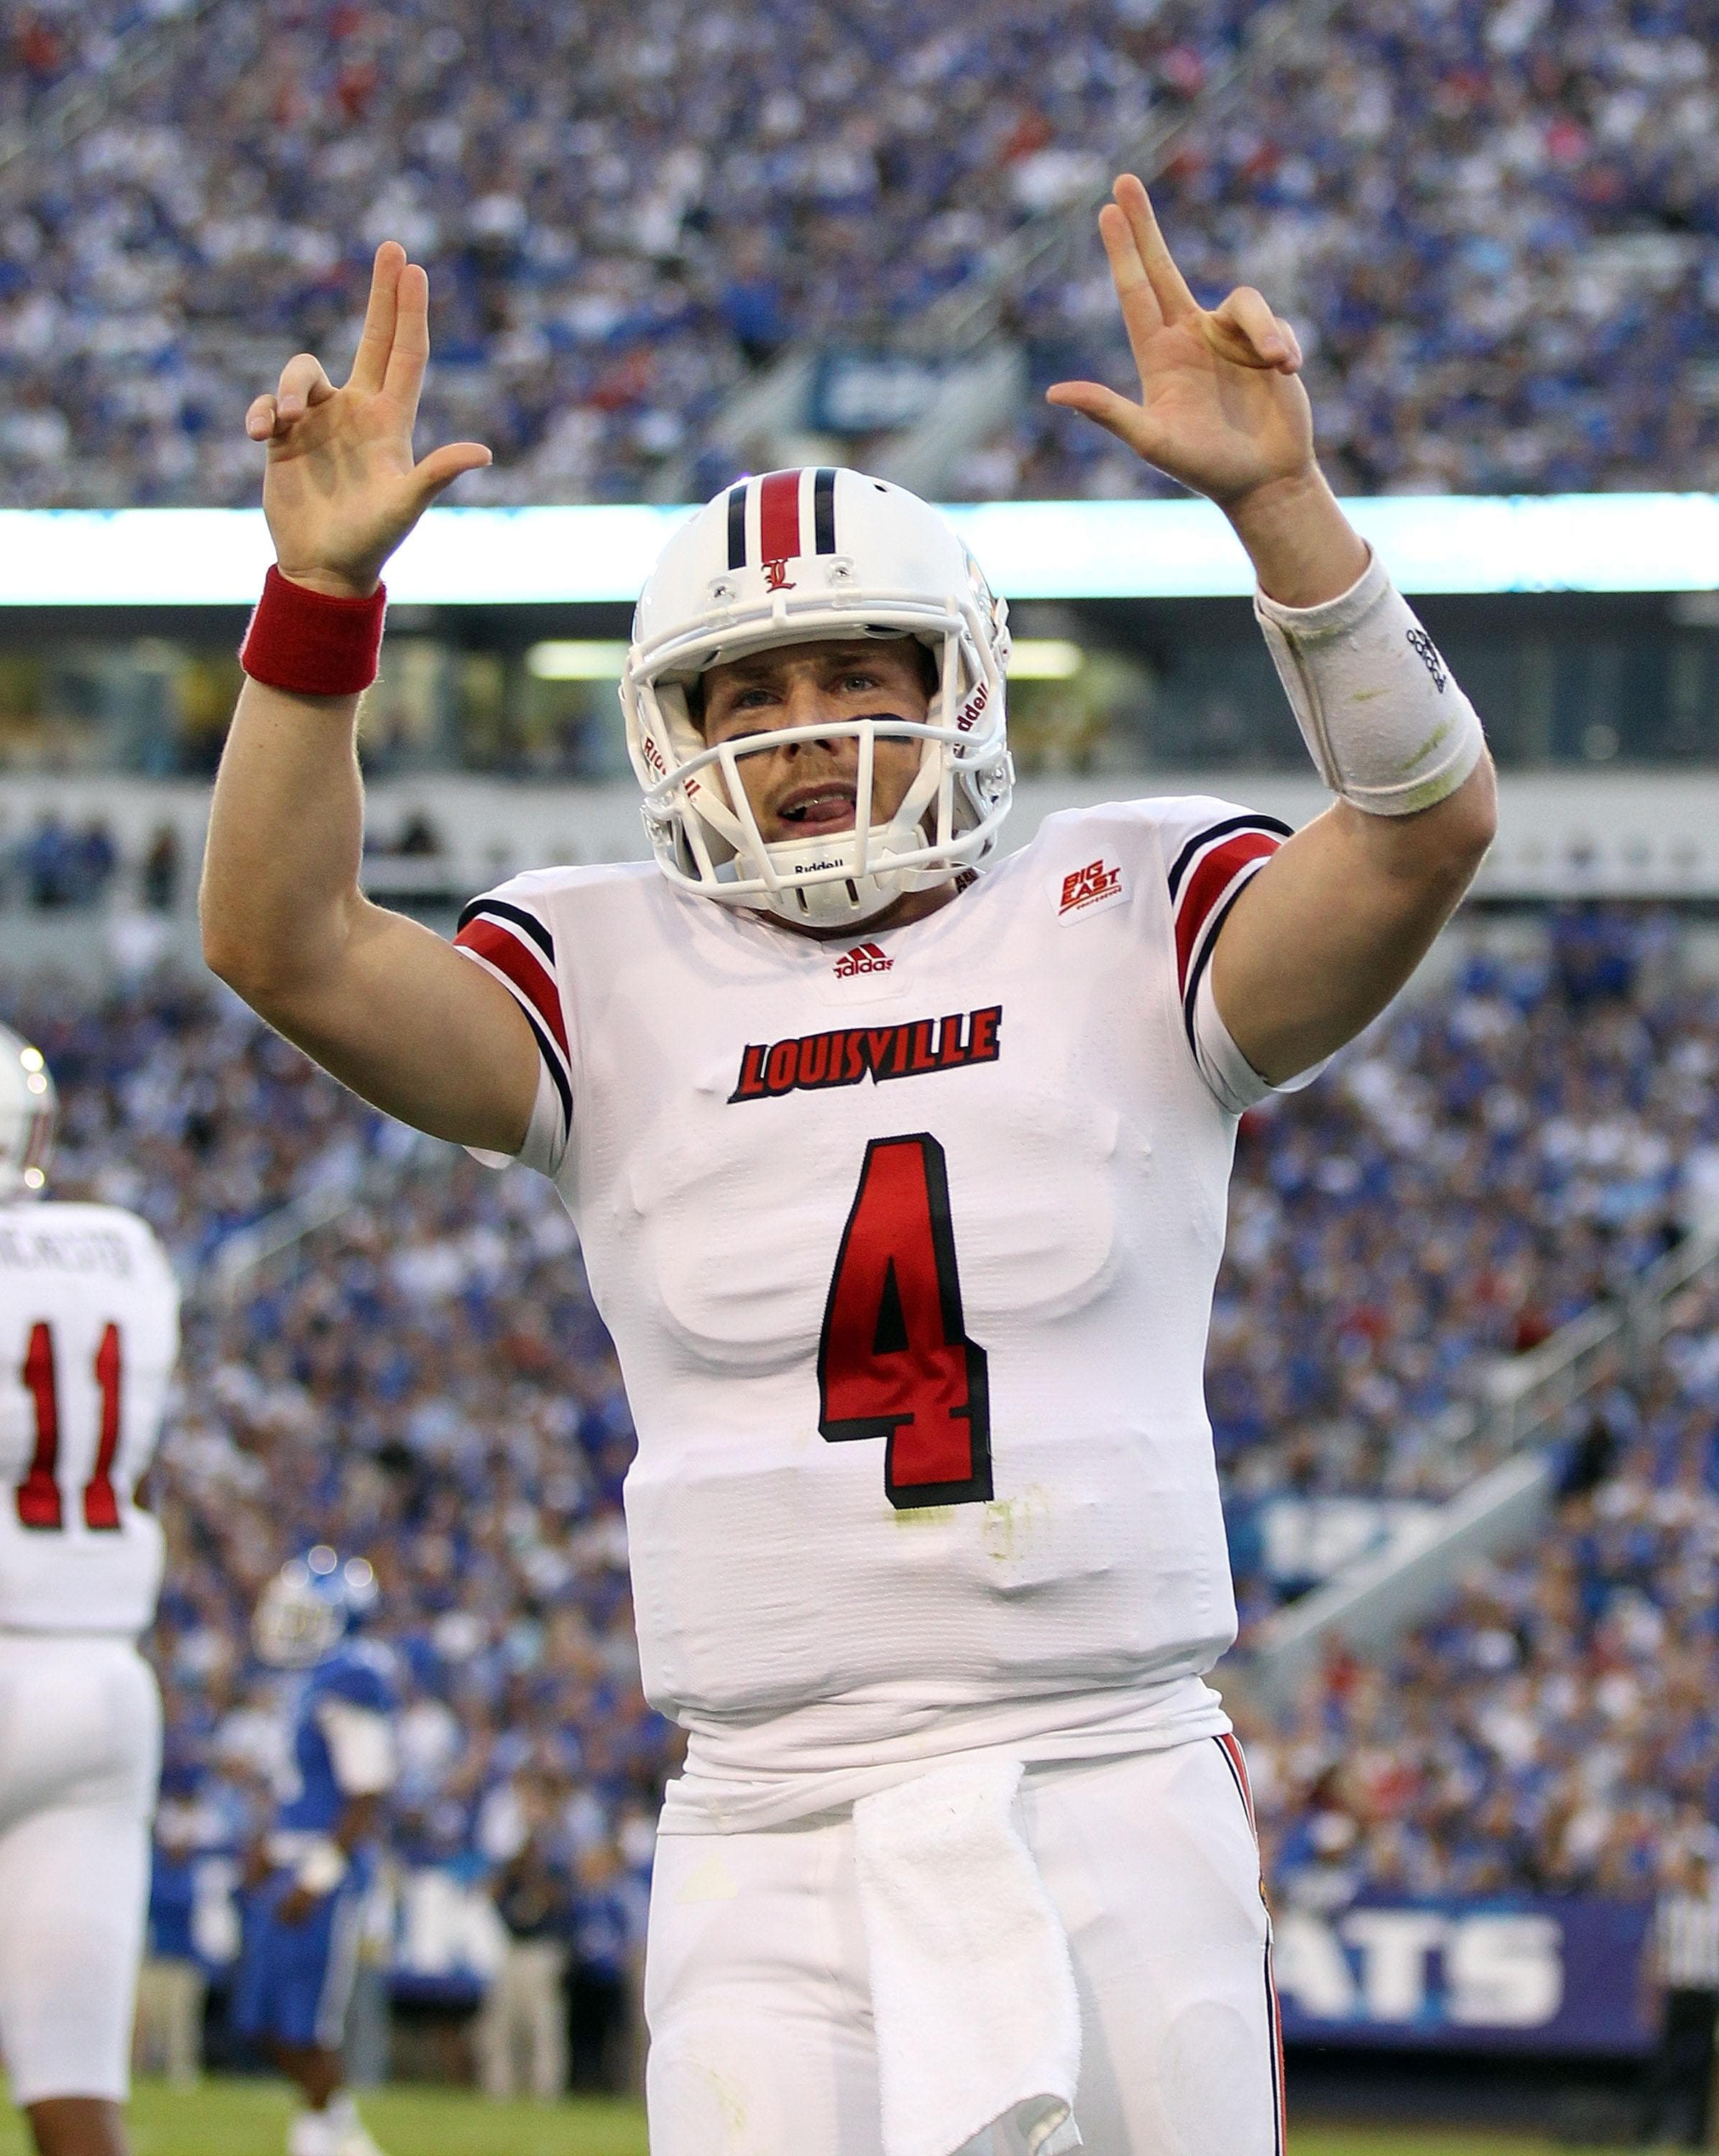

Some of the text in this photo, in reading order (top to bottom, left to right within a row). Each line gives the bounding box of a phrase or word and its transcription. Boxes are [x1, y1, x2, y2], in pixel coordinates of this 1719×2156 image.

[761, 558, 796, 594] L
[1060, 867, 1120, 906] EAST
[1063, 860, 1103, 889] BIG
[727, 1005, 1003, 1104] LOUISVILLE
[816, 1133, 993, 1510] 4
[17, 1321, 122, 1531] 11
